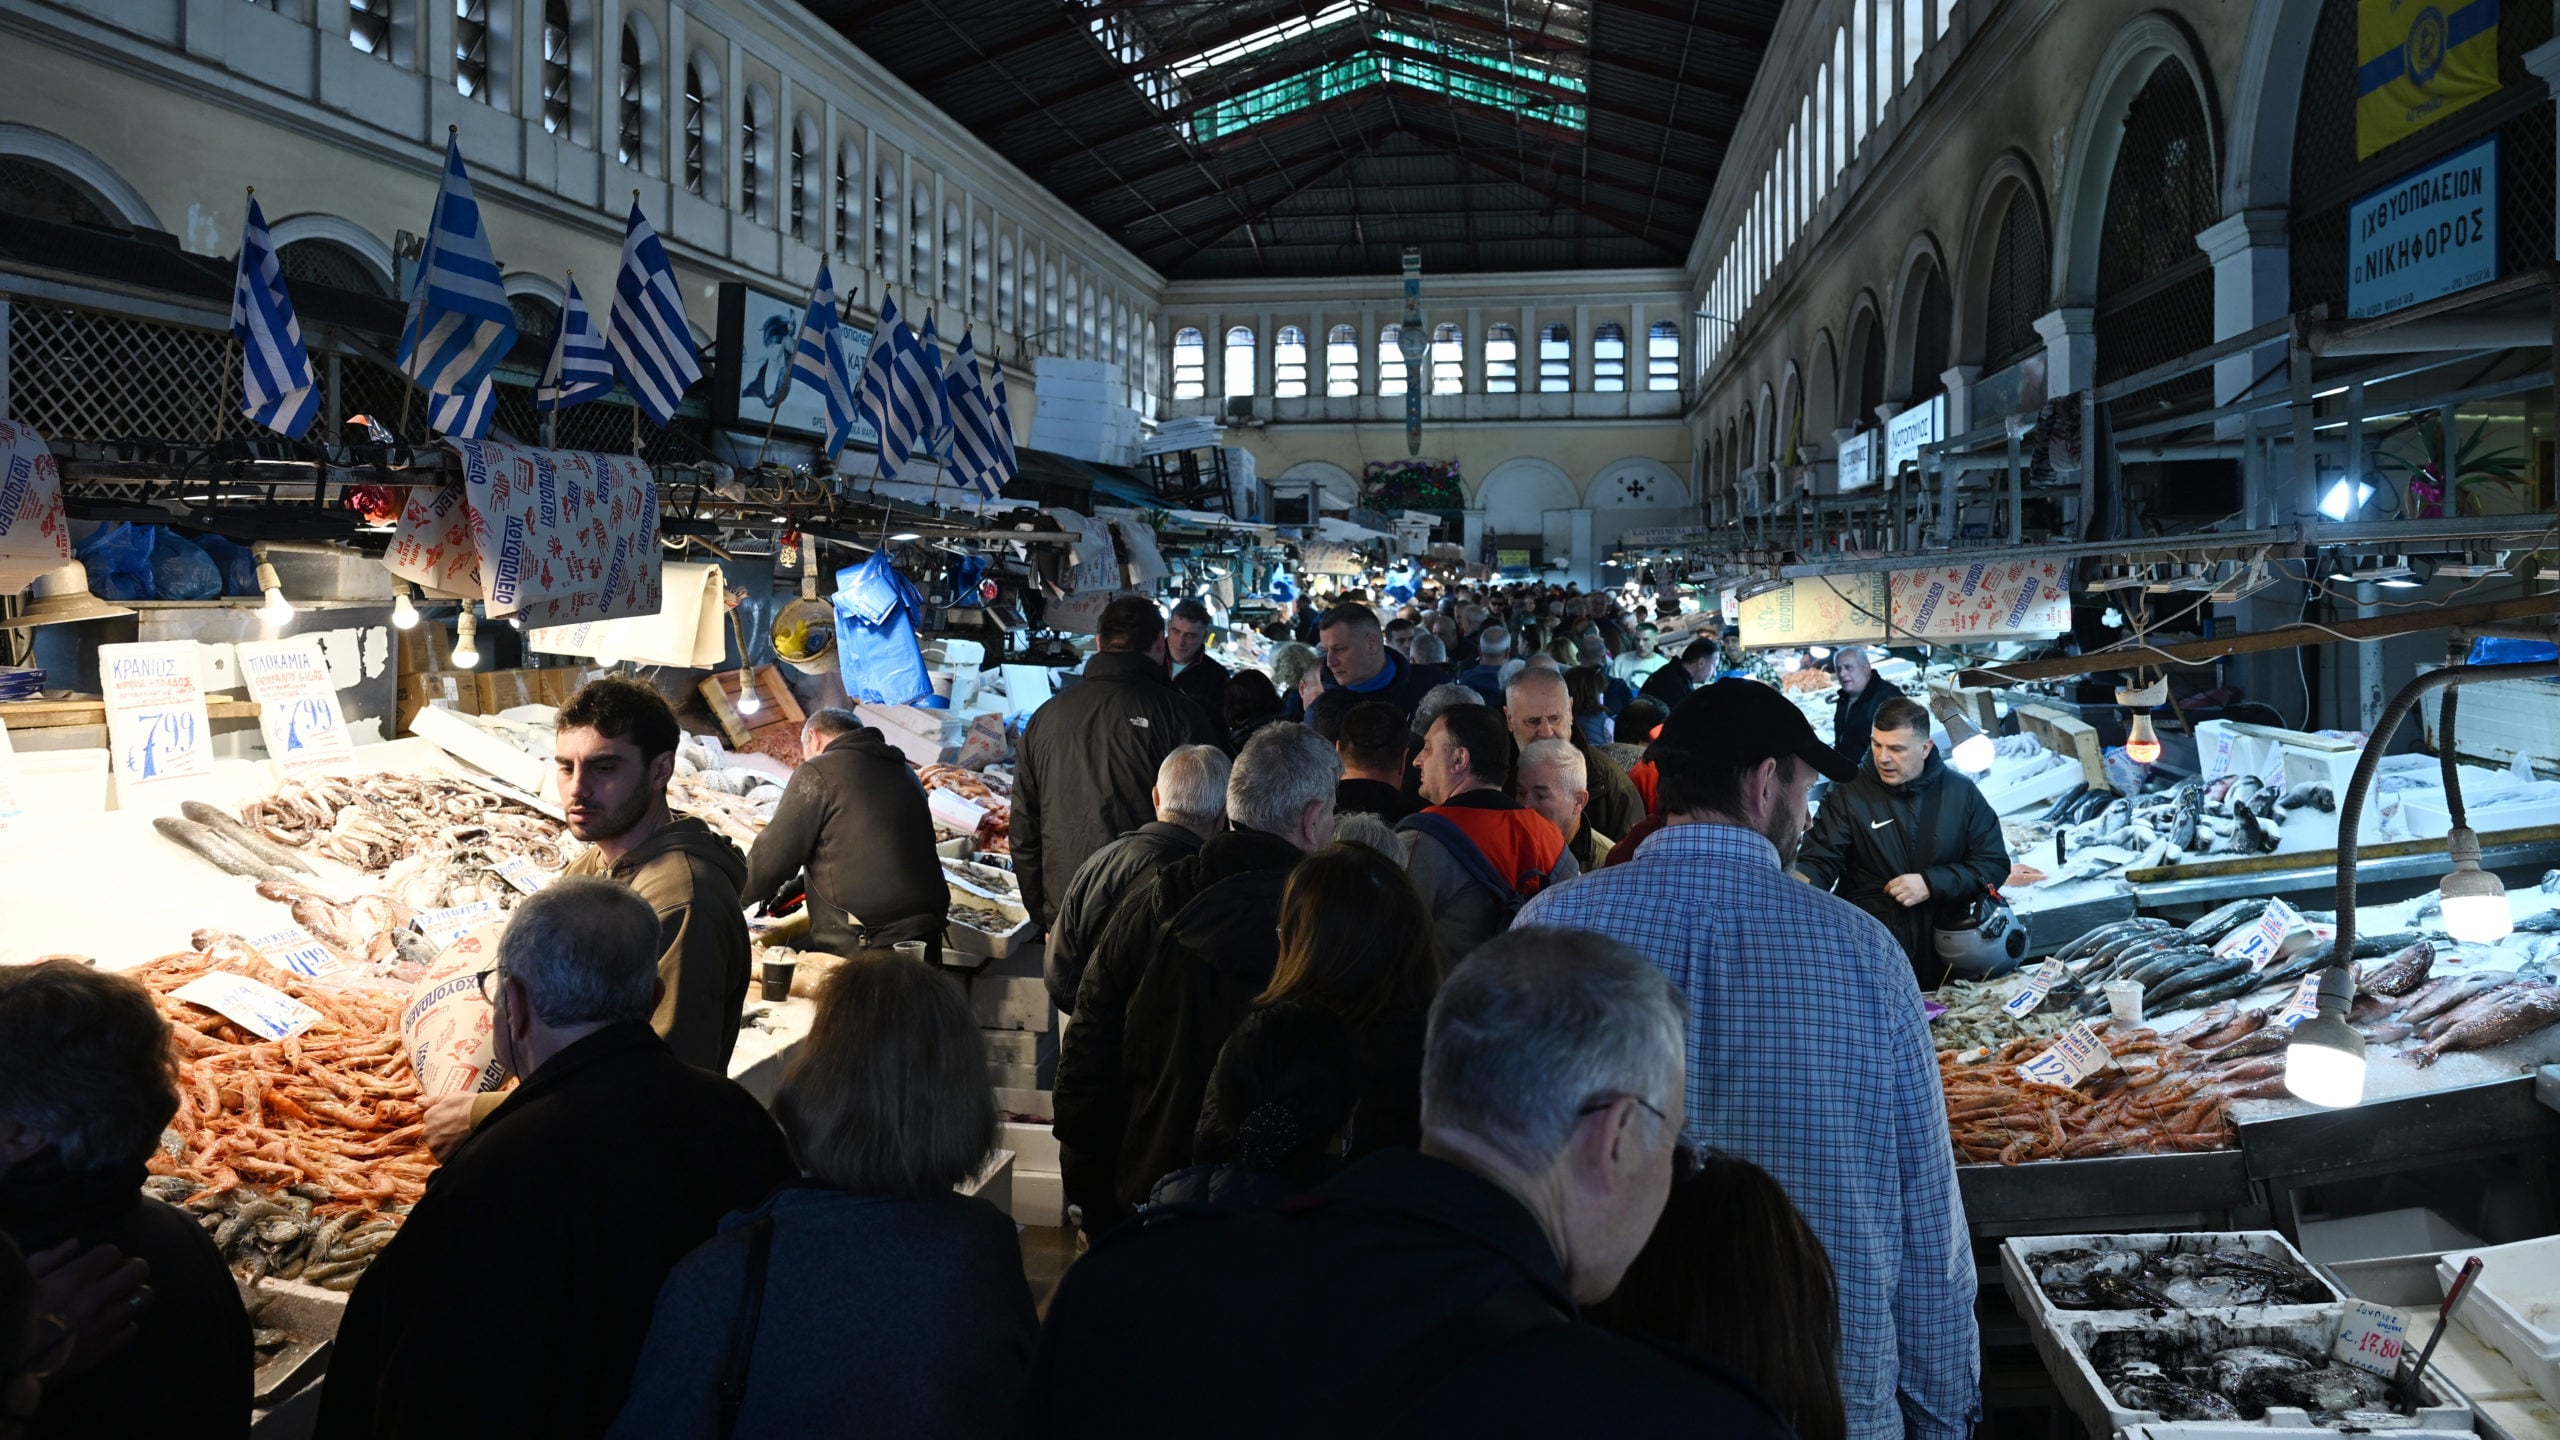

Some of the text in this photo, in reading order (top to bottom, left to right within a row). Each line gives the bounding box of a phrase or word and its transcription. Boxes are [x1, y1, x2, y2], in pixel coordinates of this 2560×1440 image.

[2362, 166, 2483, 243] ΙΧΘΥΟΠΩΛΕΙΟΝ
[2366, 207, 2484, 283] ΝΙΚΗΦΟΡΟΣ
[496, 516, 524, 604] ΙΧΘΥΟΠΩΛΕΙΟ
[601, 537, 628, 614] ΙΧΘΥΟΠΩΛΕΙΟ
[1912, 582, 1943, 635] ΙΧΘΥΟΠΩΛΕΙΟ
[2007, 576, 2039, 629] ΙΧΘΥΟΠΩΛΕΙΟ
[113, 658, 177, 679] ΚΡΑΝΙΟΣ
[249, 653, 311, 678] ΠΛΟΚΑΜΙΑ
[2075, 1023, 2099, 1050] ΓΑΡΙΔΑ
